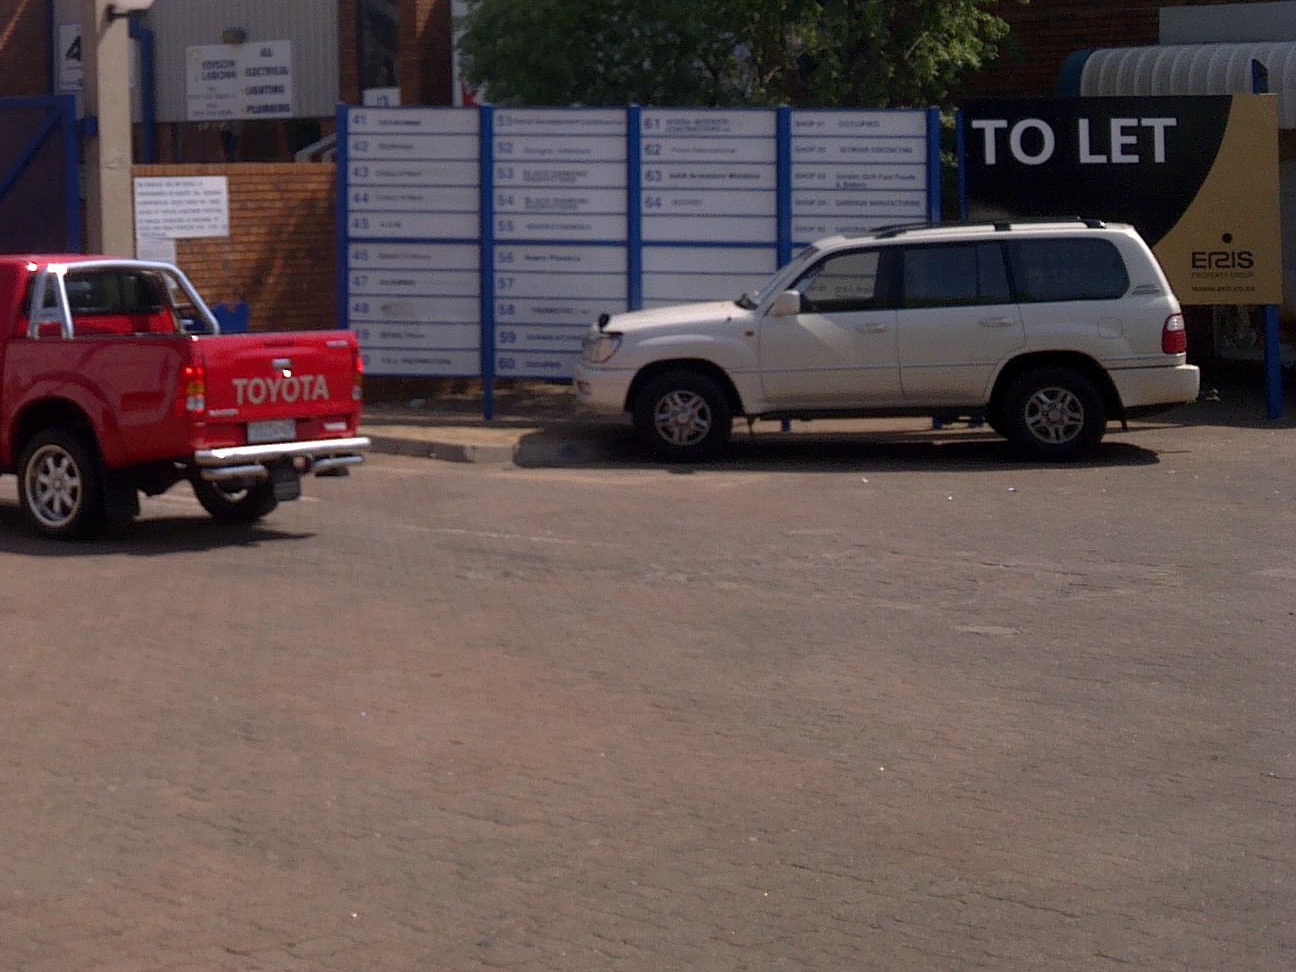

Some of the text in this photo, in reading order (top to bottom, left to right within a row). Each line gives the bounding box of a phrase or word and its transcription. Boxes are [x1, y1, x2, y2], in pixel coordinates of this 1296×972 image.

[972, 117, 1177, 165] TO LET
[1192, 251, 1254, 269] ERIS
[232, 374, 330, 405] TOYOTA
